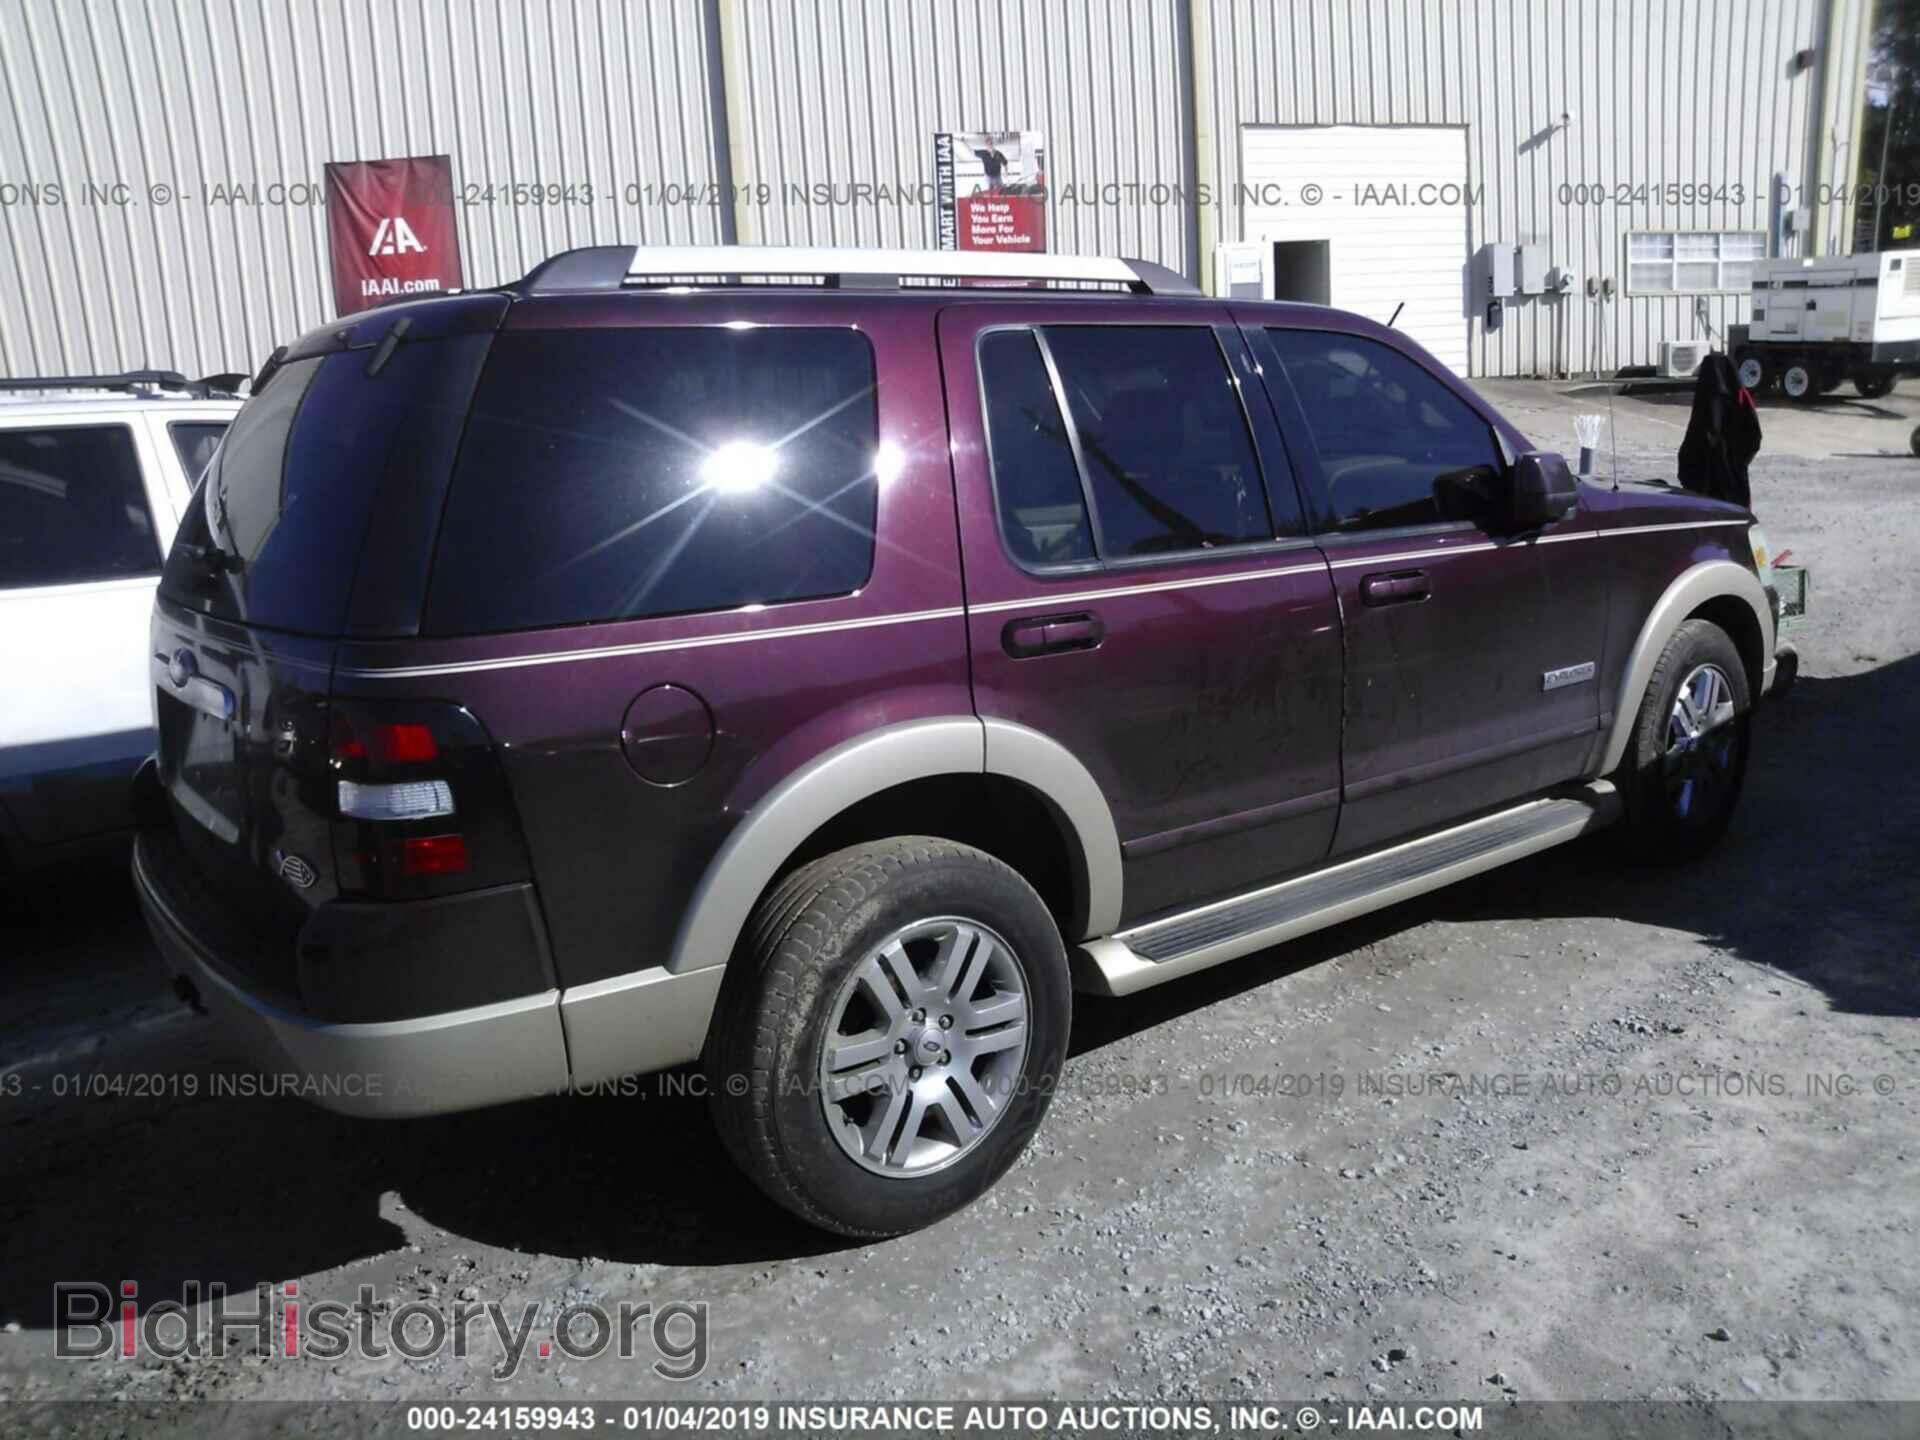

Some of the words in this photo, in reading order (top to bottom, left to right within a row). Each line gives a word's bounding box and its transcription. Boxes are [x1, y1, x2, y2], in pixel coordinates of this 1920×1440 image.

[936, 135, 951, 162] IAA
[939, 164, 954, 205] WITH
[970, 203, 985, 212] We
[988, 203, 1010, 214] Help
[971, 214, 989, 223] You
[991, 213, 1013, 223] Earn
[940, 207, 955, 251] MART
[971, 225, 996, 234] More
[998, 224, 1014, 233] For
[972, 235, 994, 245] Your
[995, 235, 1031, 244] Vehicle
[361, 278, 440, 296] IAAI.com
